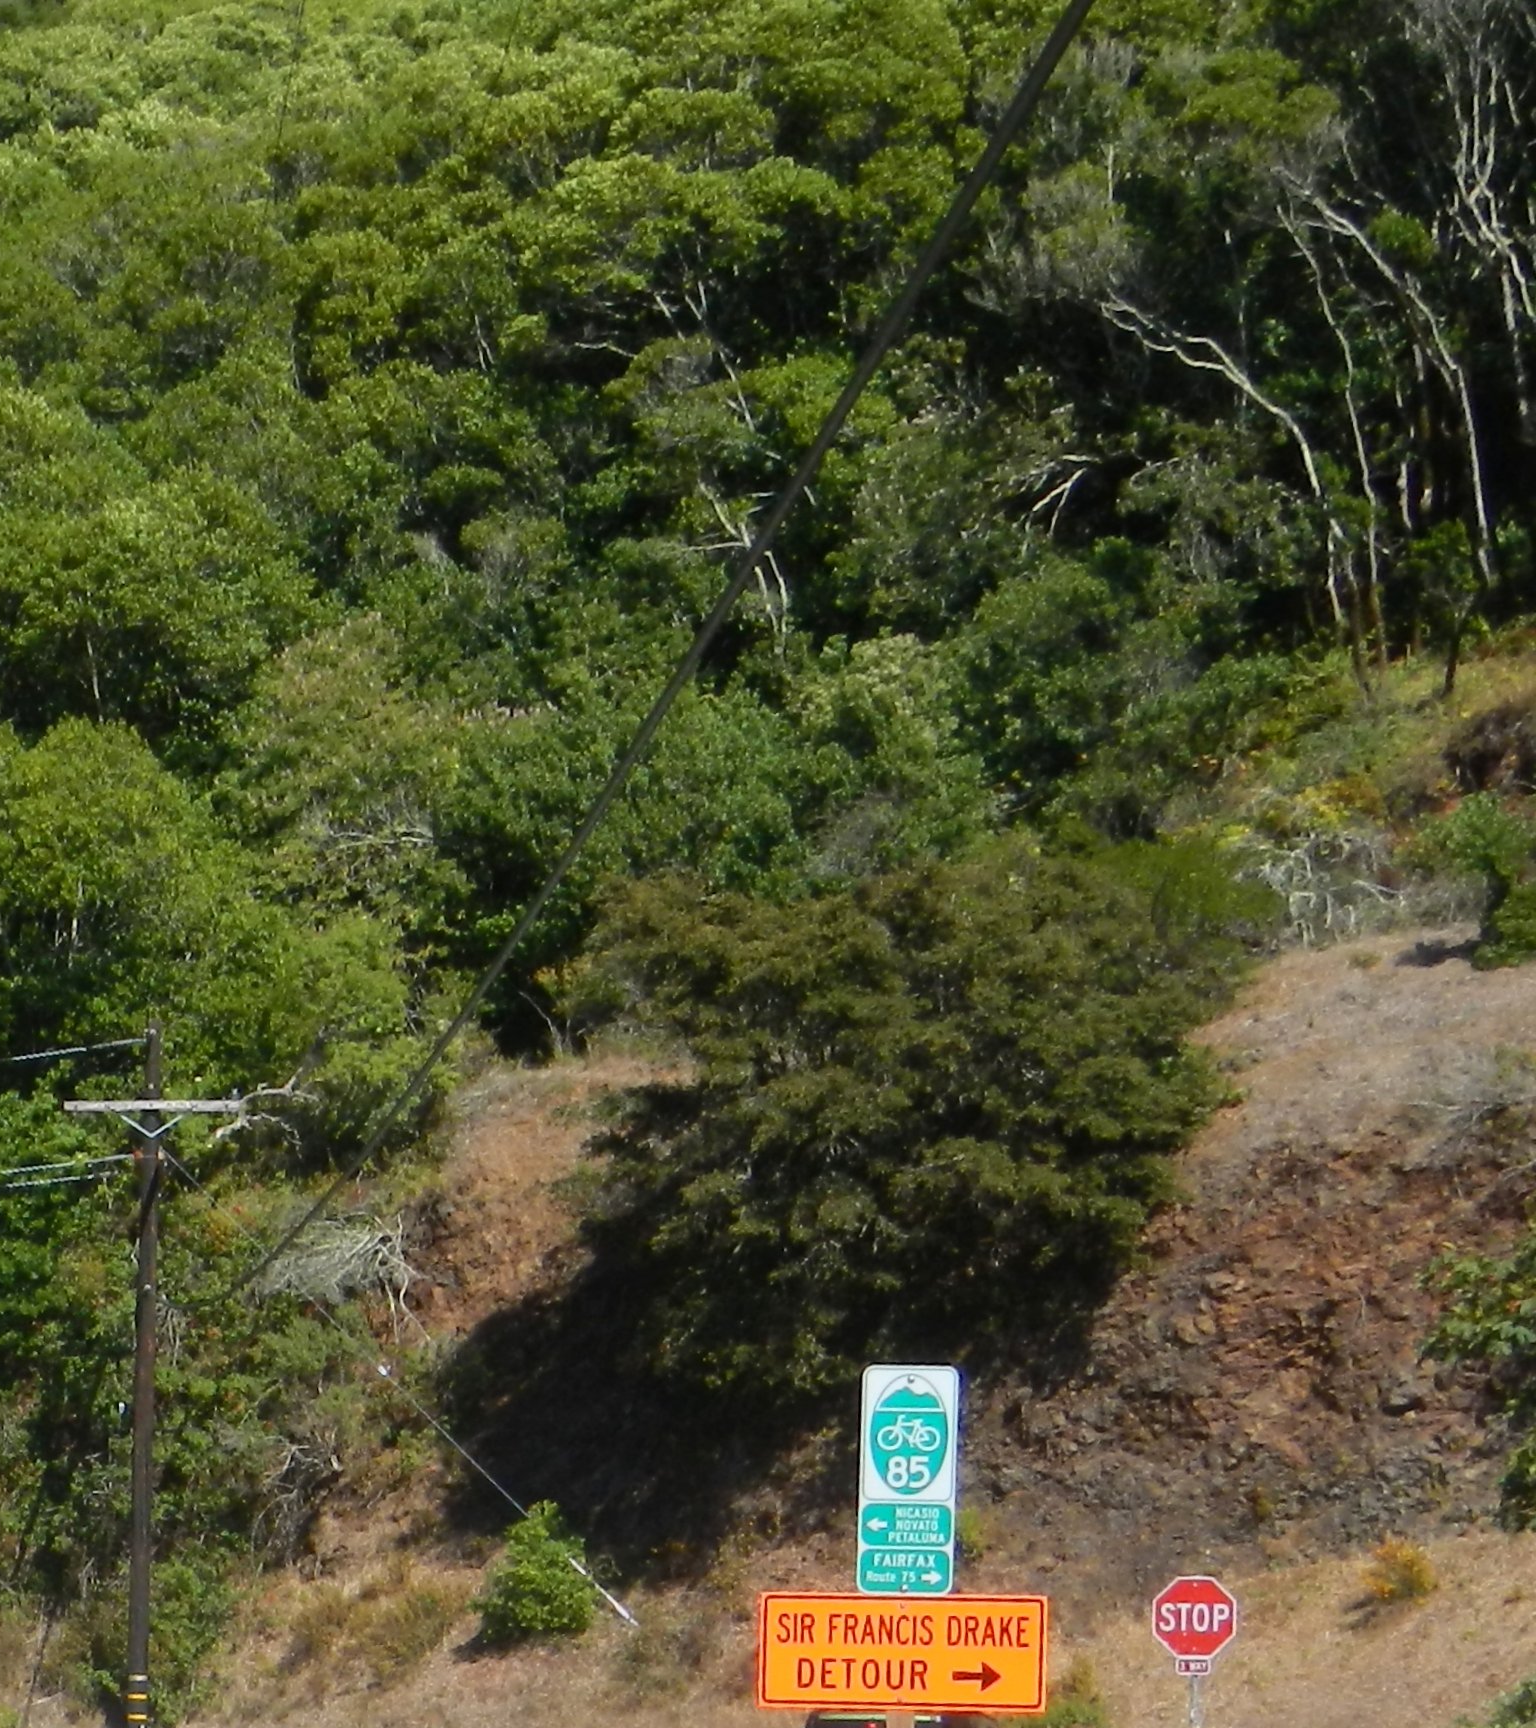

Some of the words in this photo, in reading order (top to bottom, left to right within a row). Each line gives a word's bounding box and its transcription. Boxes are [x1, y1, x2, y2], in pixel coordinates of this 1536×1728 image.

[886, 1455, 931, 1489] 85
[895, 1507, 940, 1519] NICASIO
[895, 1519, 939, 1531] NOVATO
[887, 1531, 946, 1544] PETALUMA
[873, 1553, 936, 1568] FAIRFAX
[865, 1570, 897, 1583] Route
[1159, 1602, 1230, 1633] STOP
[776, 1612, 816, 1644] SIR
[828, 1613, 934, 1646] FRANCIS
[946, 1615, 1031, 1648] DRAKE
[796, 1657, 929, 1691] DETOUR
